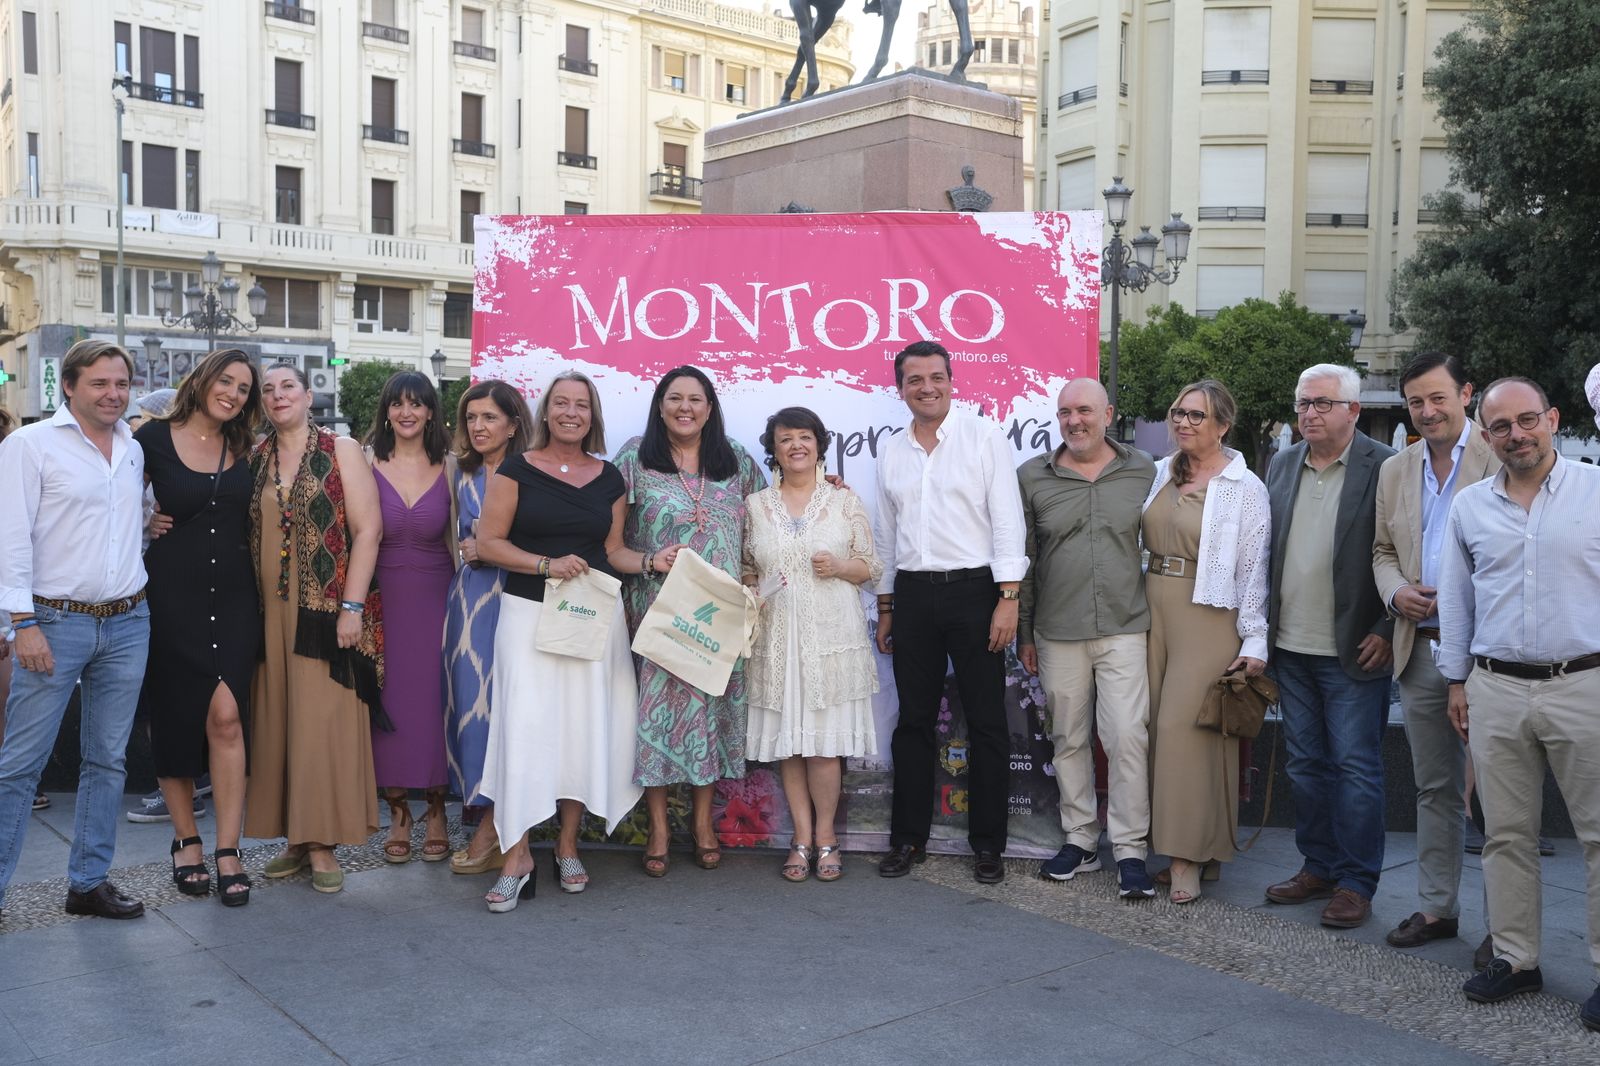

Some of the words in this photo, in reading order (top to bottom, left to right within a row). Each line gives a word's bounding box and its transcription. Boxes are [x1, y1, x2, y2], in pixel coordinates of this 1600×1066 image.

[563, 276, 1006, 352] MONTORO
[44, 358, 56, 410] FARMACIA
[570, 605, 597, 617] sadeco
[672, 615, 721, 653] sadeco
[1009, 761, 1033, 771] ORO
[1008, 805, 1033, 816] doba
